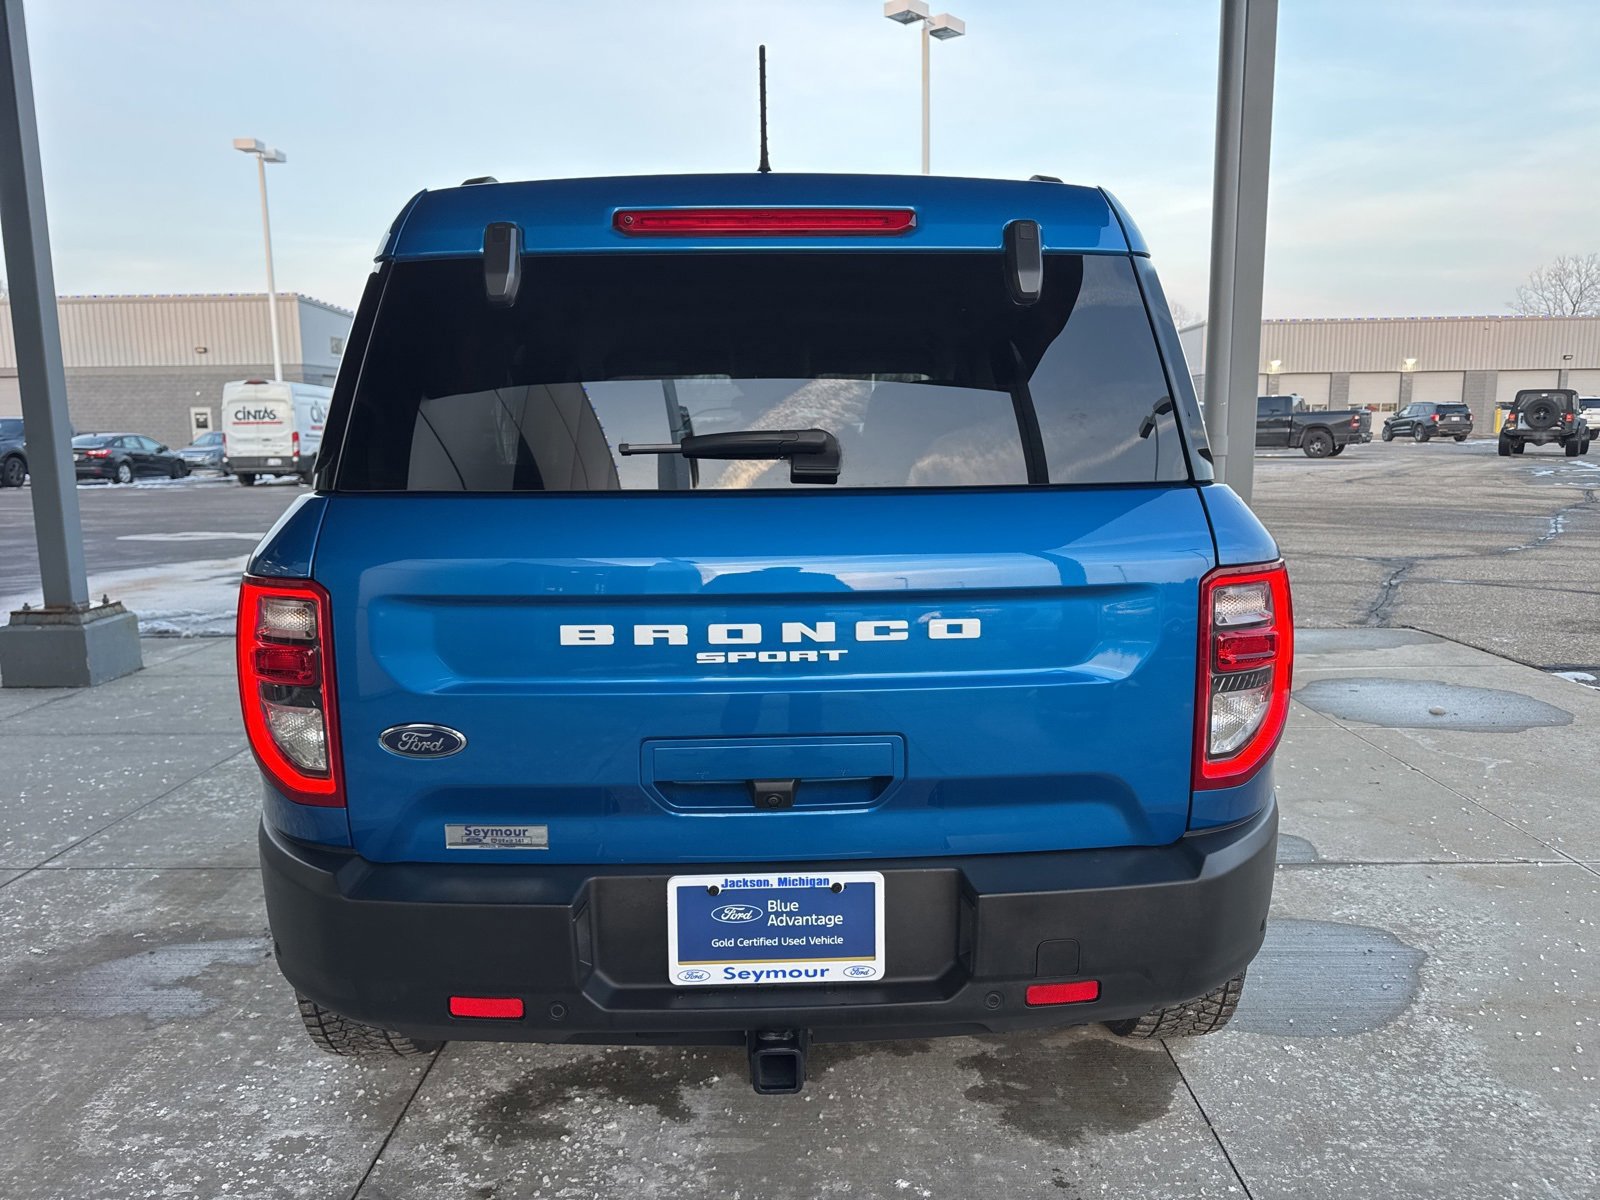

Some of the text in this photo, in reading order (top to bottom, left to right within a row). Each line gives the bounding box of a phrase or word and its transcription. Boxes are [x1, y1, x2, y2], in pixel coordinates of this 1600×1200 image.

[559, 618, 981, 646] BRONCO
[696, 649, 848, 664] SPORT
[397, 731, 444, 751] Ford
[464, 825, 528, 839] Seymour
[721, 877, 830, 888] Jackson, Michigan
[767, 900, 799, 912] Blue
[720, 907, 753, 921] Ford
[767, 913, 844, 928] Advantage
[711, 935, 844, 948] Gold Certified Used Vehicle
[684, 970, 704, 980] Ford
[723, 966, 830, 982] Seymour
[849, 967, 870, 977] Ford
